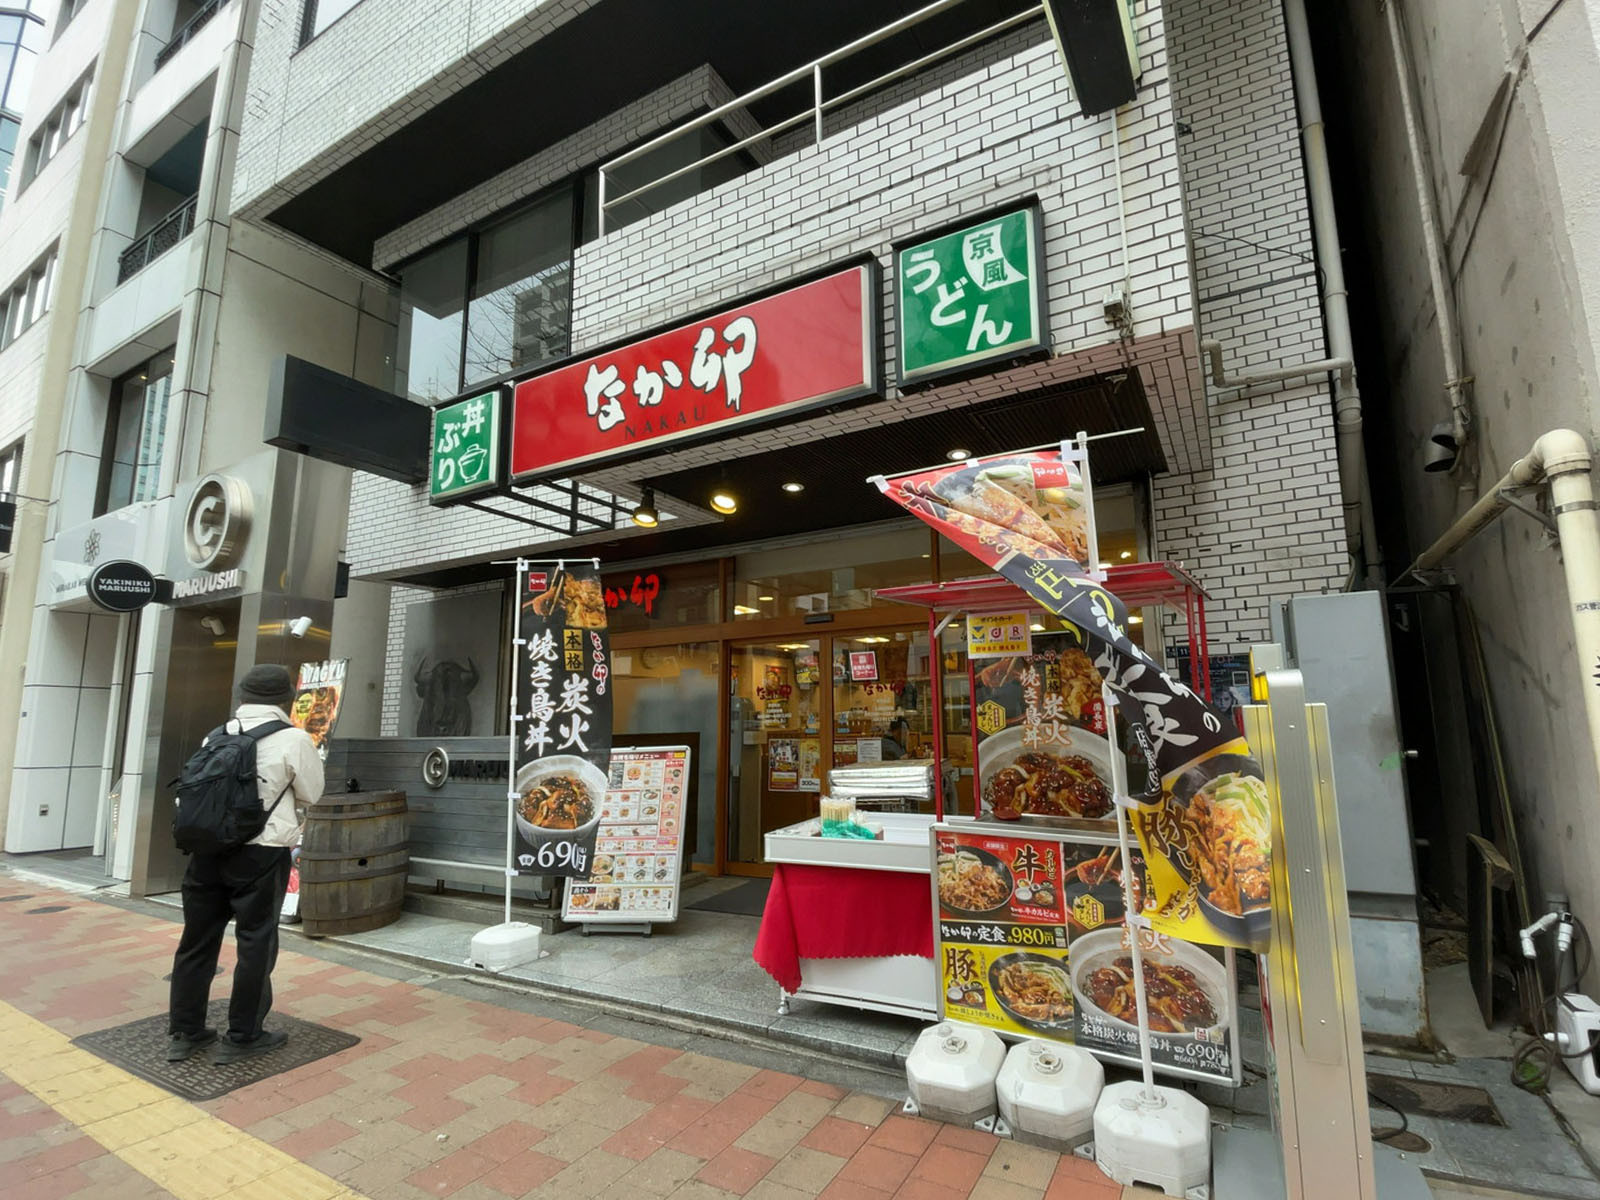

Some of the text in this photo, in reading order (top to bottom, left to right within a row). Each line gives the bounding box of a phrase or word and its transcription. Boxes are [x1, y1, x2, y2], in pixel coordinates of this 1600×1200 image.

[903, 248, 1013, 352] うどん
[583, 314, 759, 432] なか卯
[625, 406, 709, 440] NAKAU
[98, 585, 150, 593] MARUUSHI
[99, 577, 150, 587] YAKINIKU
[172, 568, 240, 599] MARUUSHI
[564, 630, 583, 670] 本格
[524, 628, 559, 757] 焼き鳥丼
[556, 673, 593, 752] 炭火
[1020, 664, 1043, 750] 焼き鳥丼
[1042, 692, 1072, 745] 炭火
[1011, 843, 1047, 885] 牛
[944, 947, 979, 982] 豚
